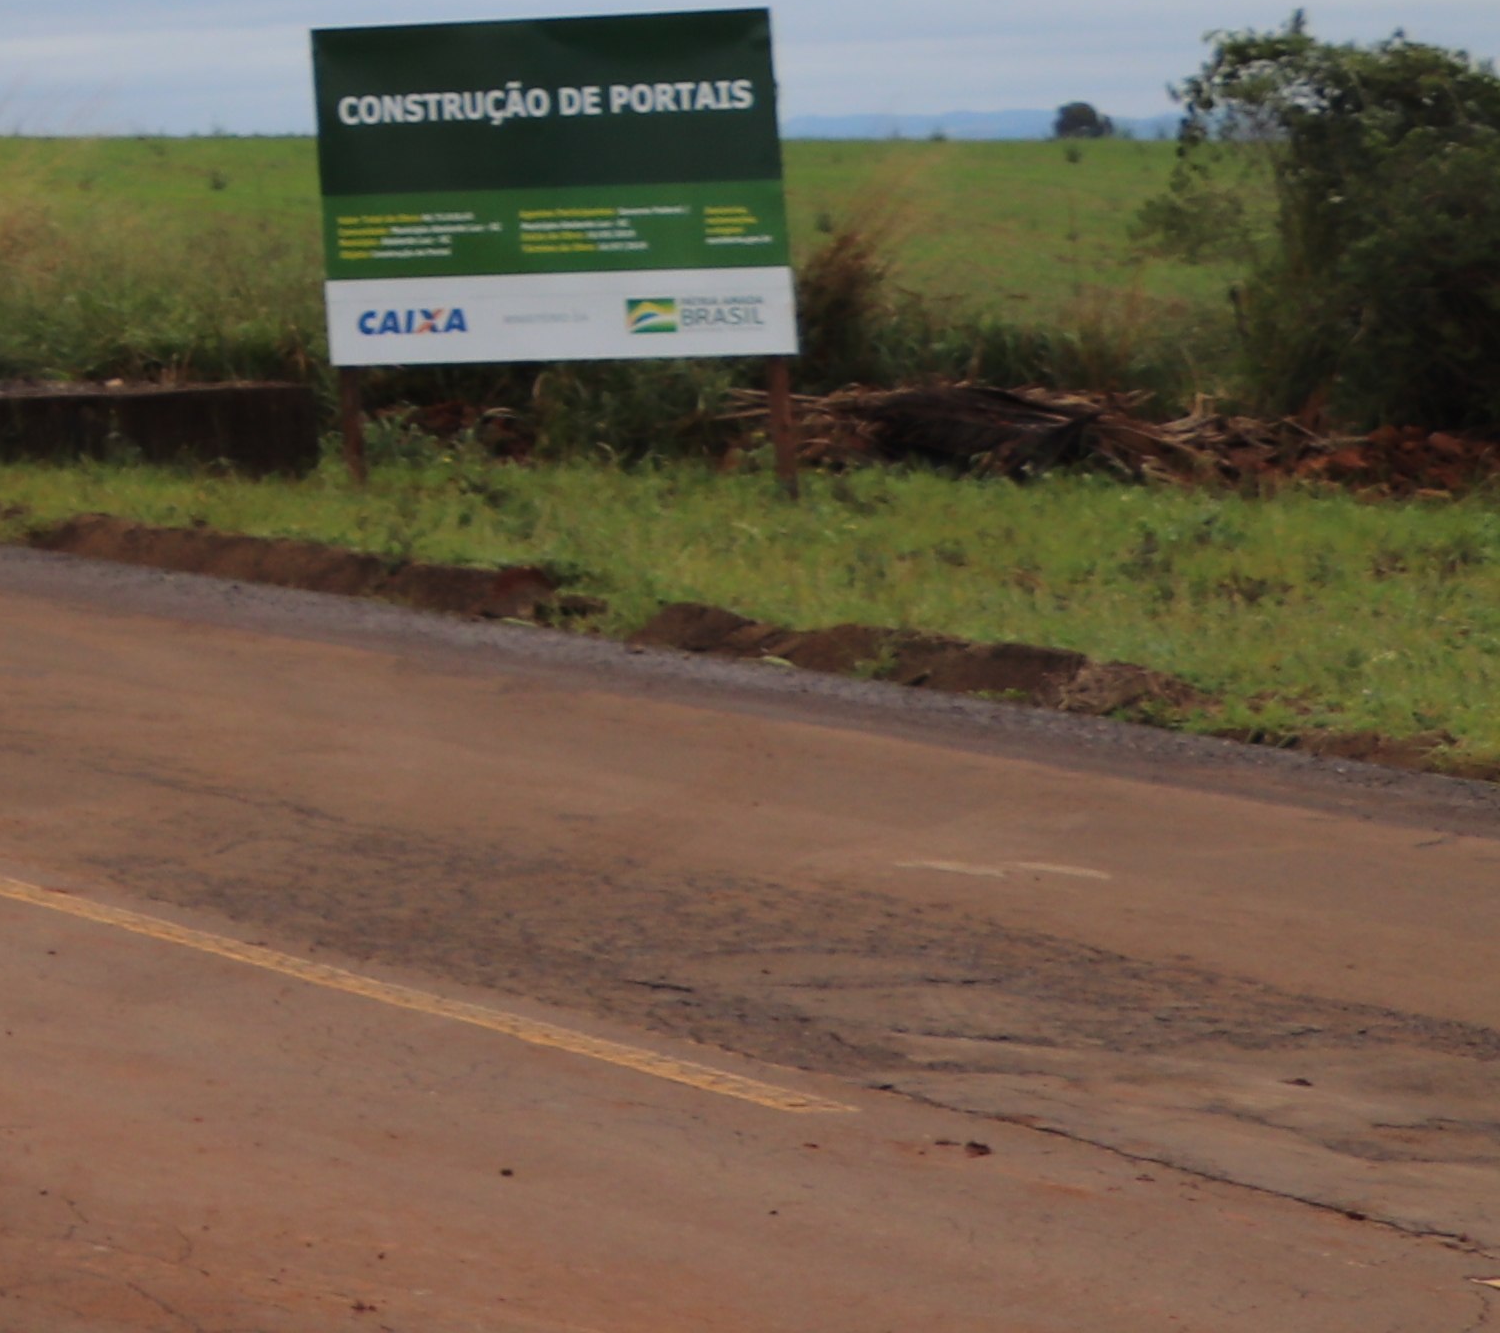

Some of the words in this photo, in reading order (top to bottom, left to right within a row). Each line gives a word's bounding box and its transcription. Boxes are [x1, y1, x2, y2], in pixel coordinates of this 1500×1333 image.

[338, 81, 551, 126] CONSTRUÇÃO
[558, 86, 602, 116] DE
[609, 79, 754, 114] PORTAIS
[357, 308, 468, 335] CAIXA
[680, 306, 765, 327] BRASIL
